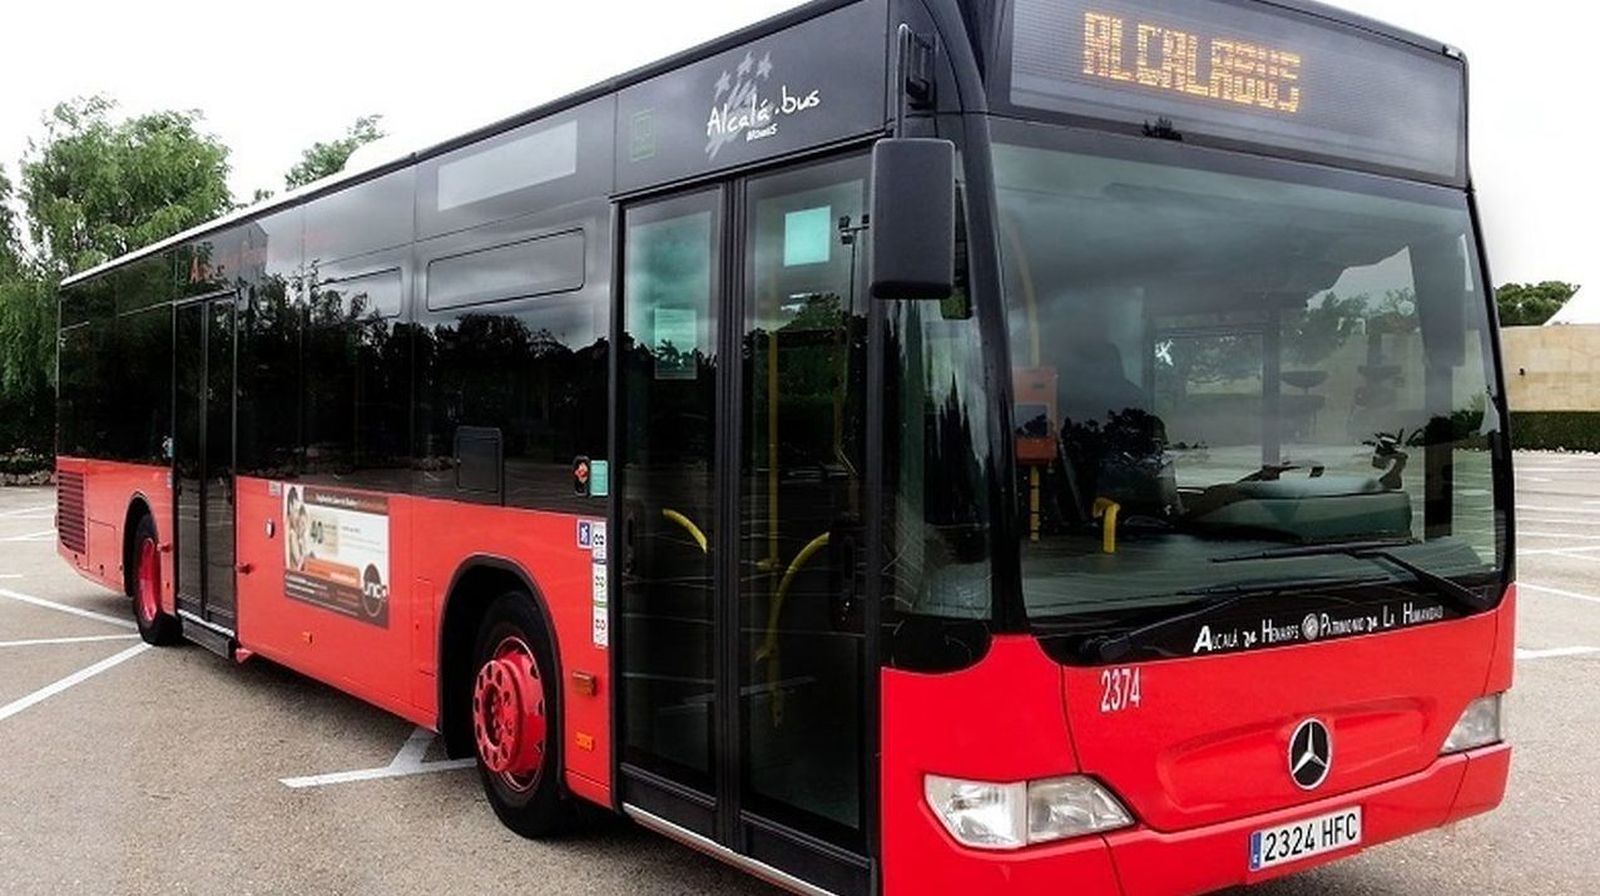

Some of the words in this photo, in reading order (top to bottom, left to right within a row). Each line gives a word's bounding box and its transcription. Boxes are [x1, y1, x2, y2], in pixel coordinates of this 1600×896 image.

[1084, 12, 1301, 112] ALCALABUS
[1101, 667, 1141, 712] 2374
[1264, 823, 1315, 862] 2324
[1321, 813, 1357, 847] HFC
